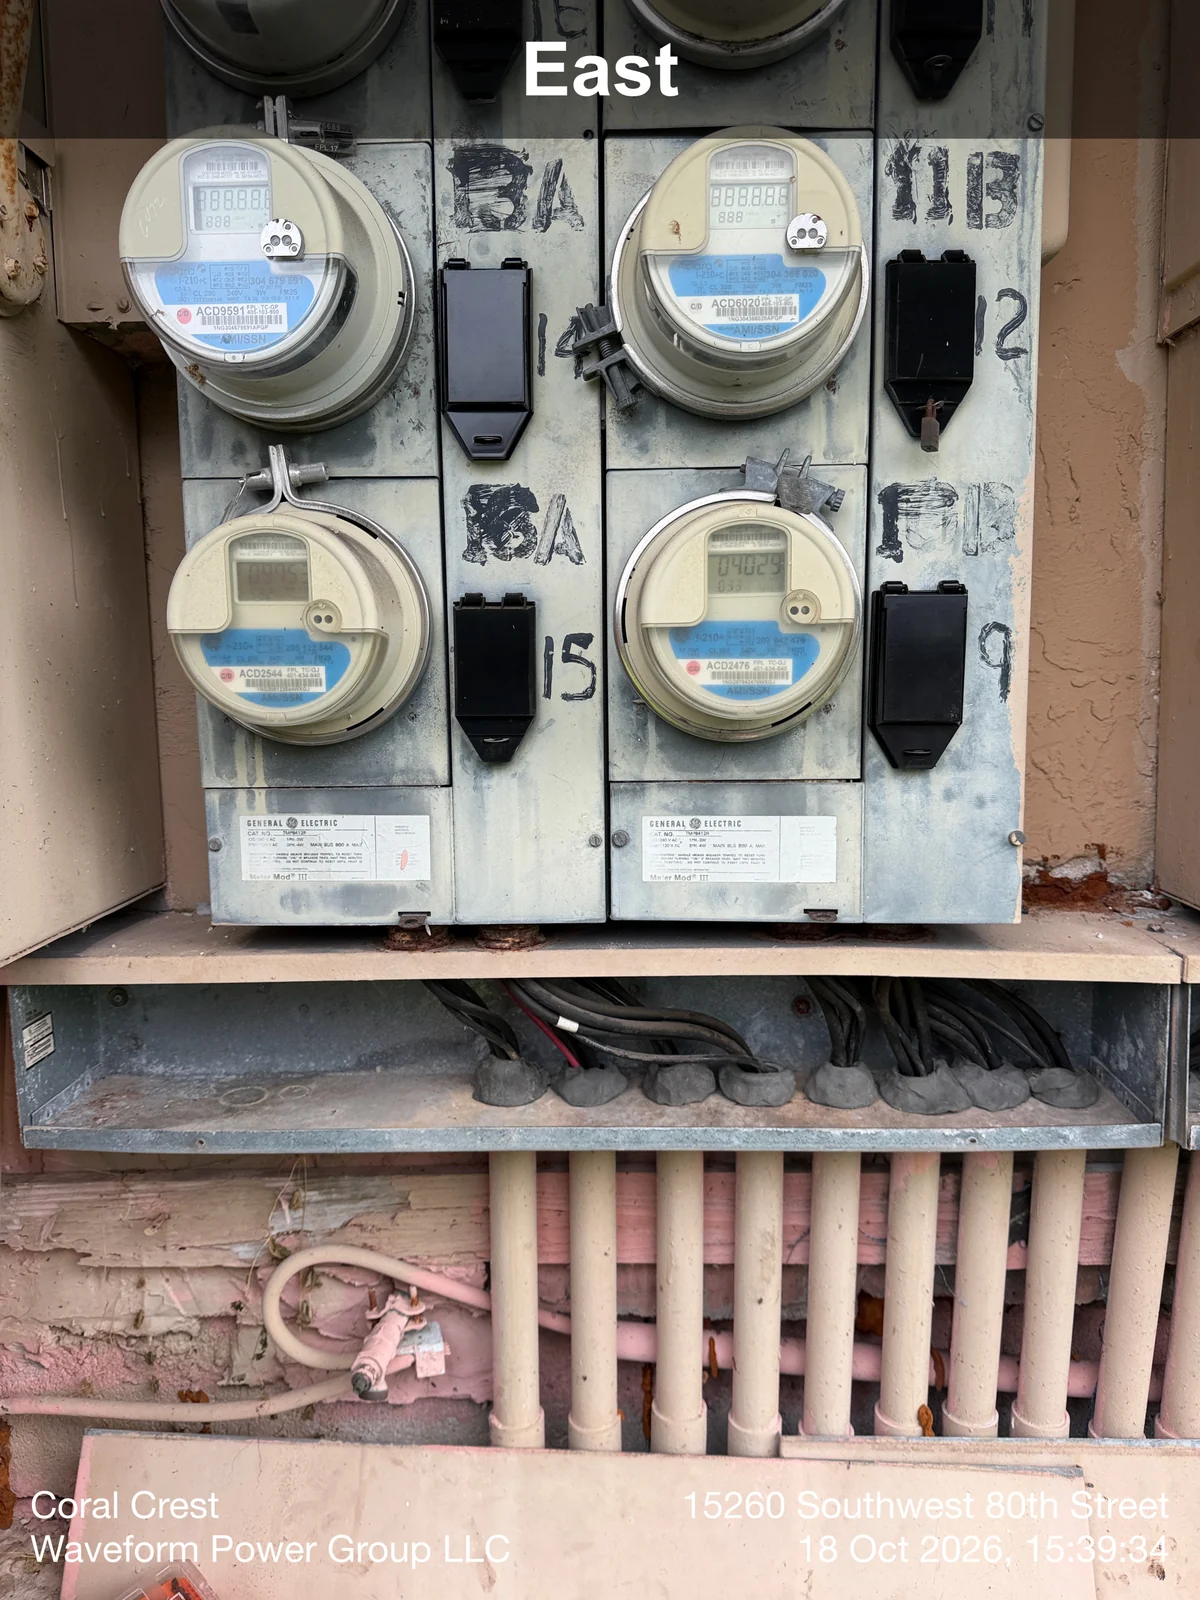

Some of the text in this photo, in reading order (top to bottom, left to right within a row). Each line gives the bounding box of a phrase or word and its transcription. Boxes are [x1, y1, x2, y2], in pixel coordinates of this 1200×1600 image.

[314, 144, 328, 152] FPL
[250, 278, 266, 286] 304
[270, 277, 285, 285] 679
[712, 298, 760, 309] ACD6020
[196, 306, 245, 316] ACD9591
[974, 287, 1029, 362] 12
[734, 325, 780, 335] AMI/SSN
[220, 334, 266, 344] AMI/SSN
[538, 312, 588, 379] 14
[542, 632, 597, 701] 15
[706, 661, 750, 670] ACD2476
[978, 621, 1013, 704] 9
[239, 669, 282, 678] ACD2544
[727, 687, 770, 695] AMI/SSN
